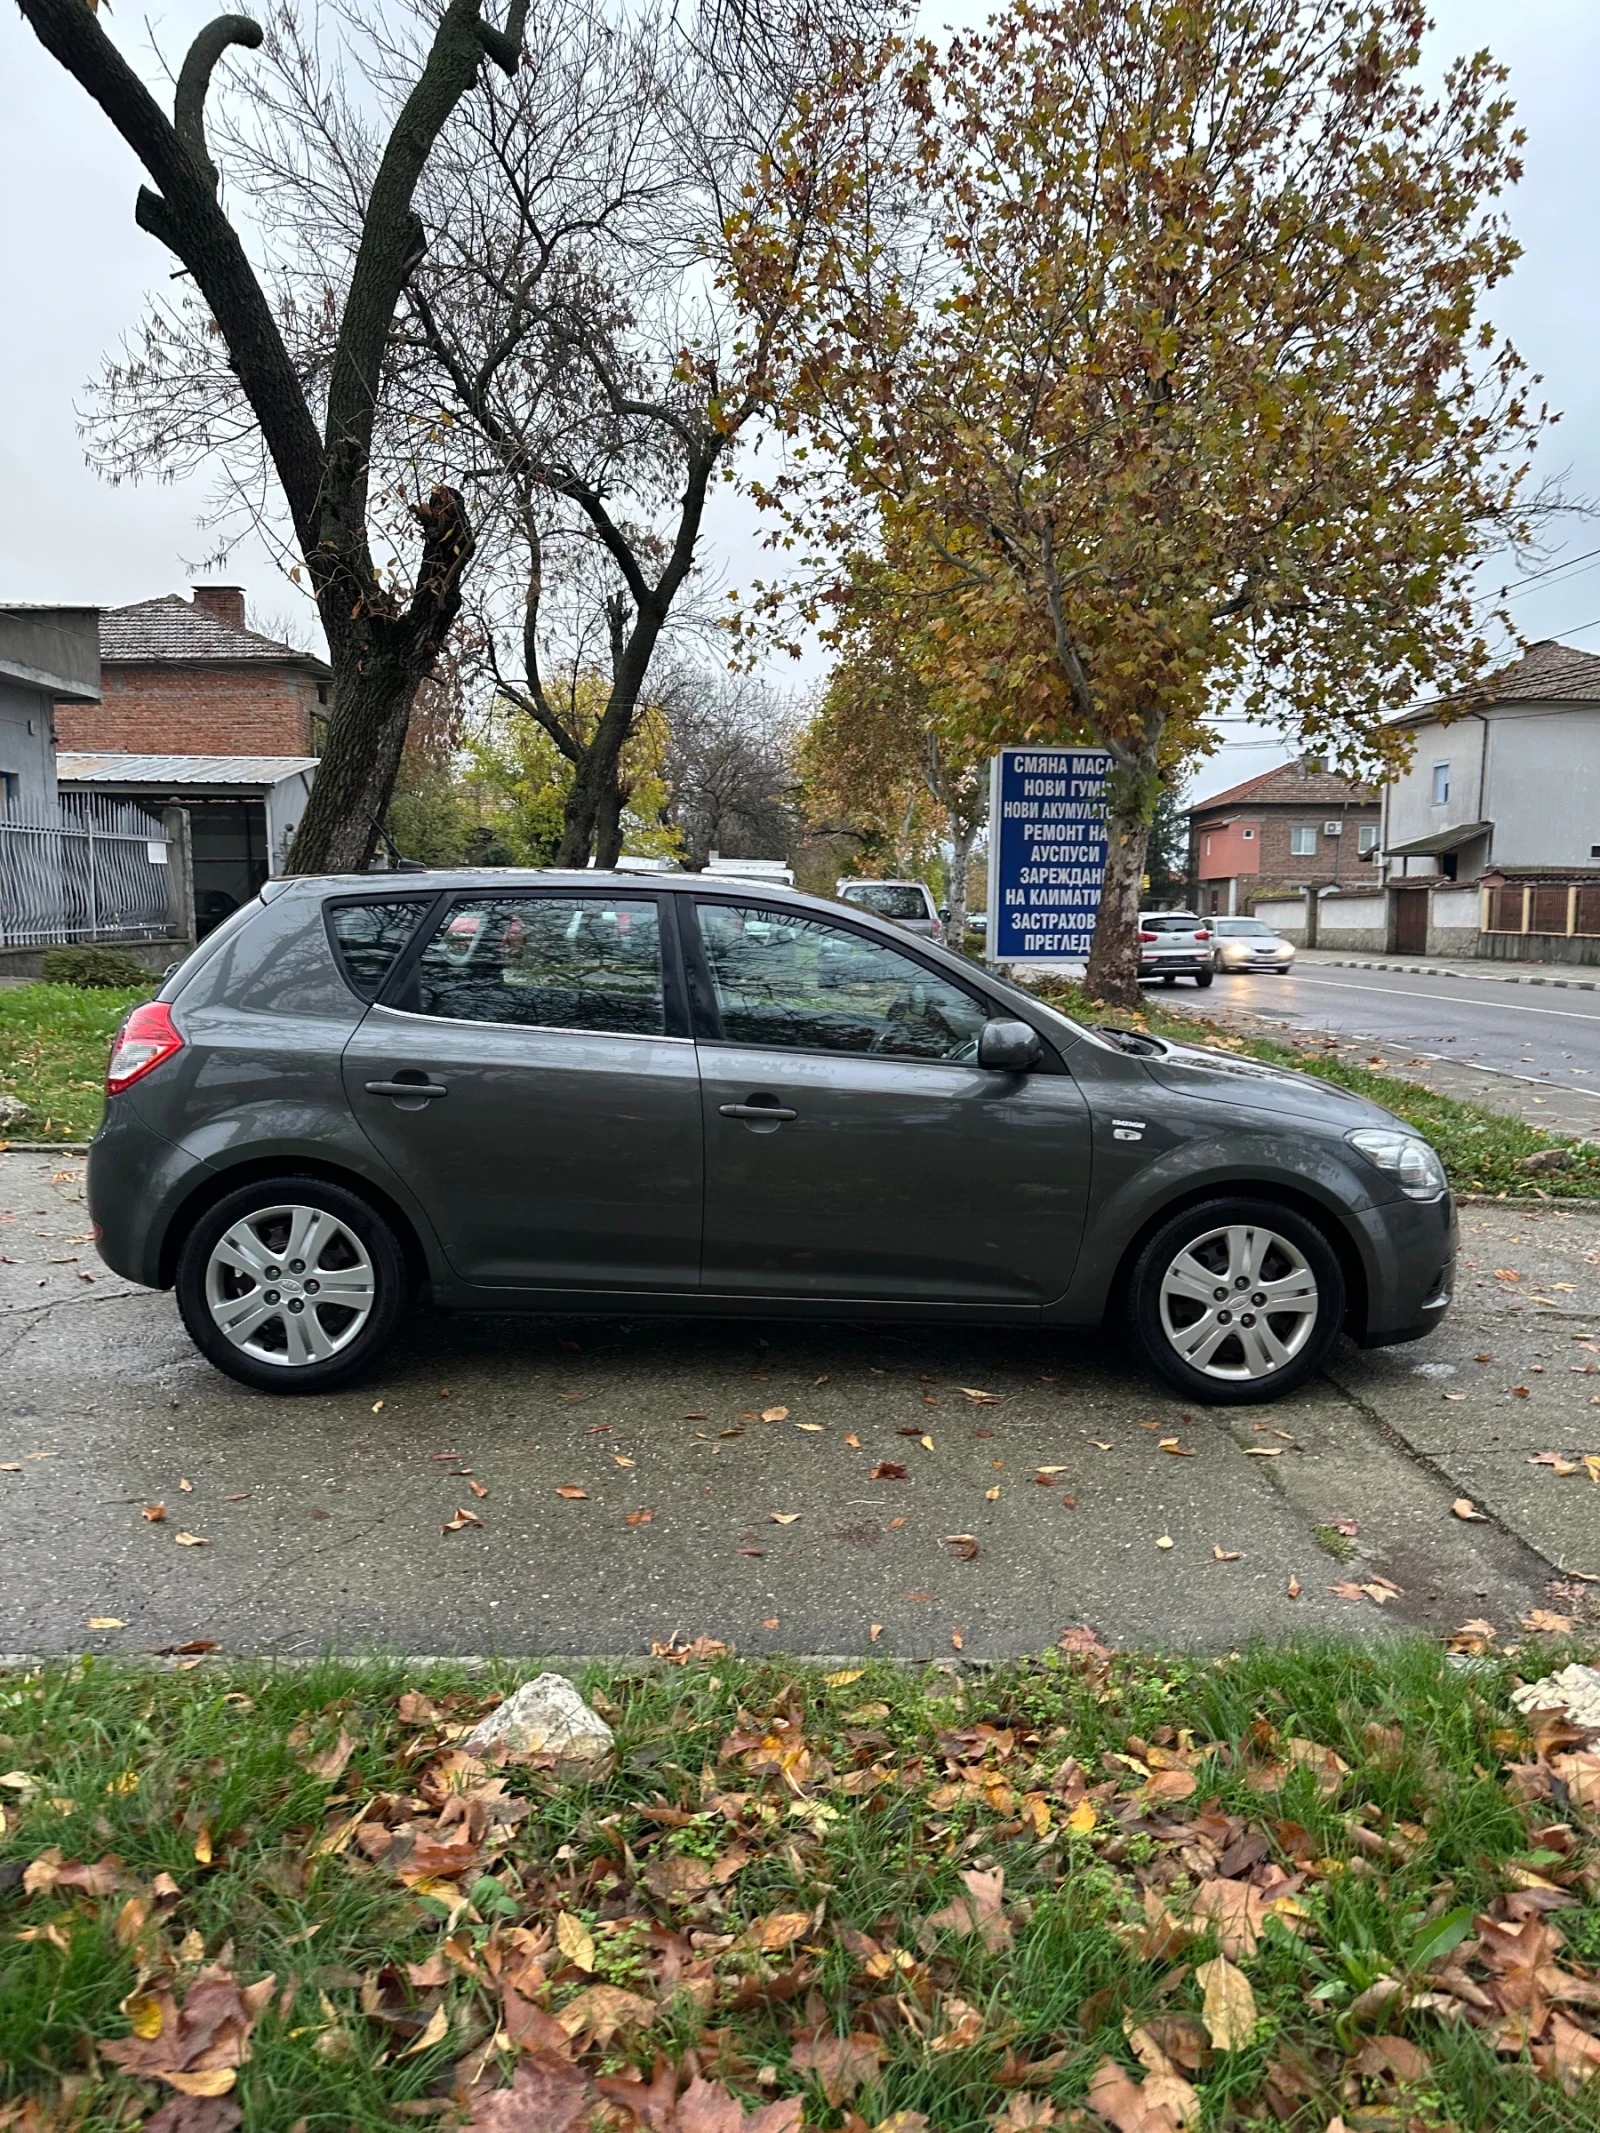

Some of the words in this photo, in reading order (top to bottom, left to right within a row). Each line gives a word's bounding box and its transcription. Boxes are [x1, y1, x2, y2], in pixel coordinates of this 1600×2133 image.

[1014, 755, 1068, 774] СМЯНА
[1072, 757, 1119, 775] МАСЛ
[1024, 779, 1066, 797] НОВИ
[1003, 801, 1039, 819] НОВИ
[1023, 823, 1085, 842] РЕМОНТ
[1088, 824, 1108, 842] НА
[1030, 845, 1100, 863] АУСПУСИ
[1005, 888, 1026, 906] НА
[1024, 934, 1094, 954] ПРЕГЛЕД
